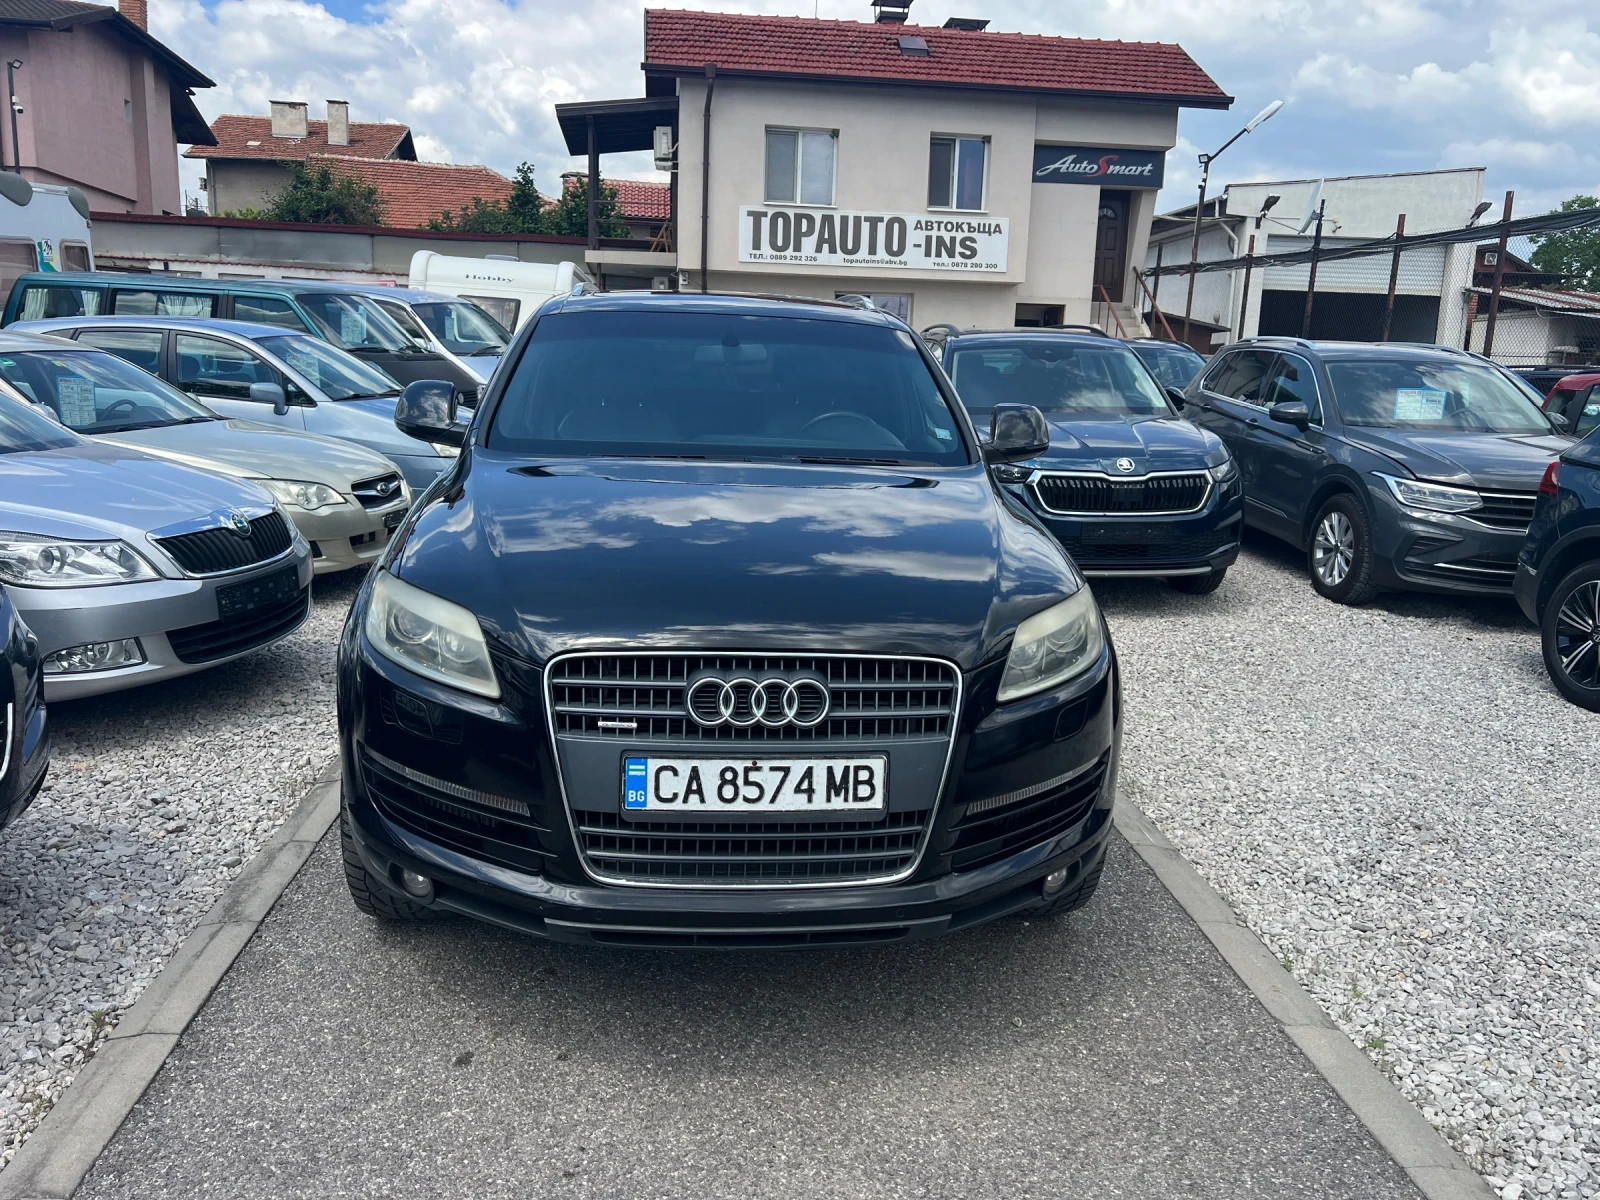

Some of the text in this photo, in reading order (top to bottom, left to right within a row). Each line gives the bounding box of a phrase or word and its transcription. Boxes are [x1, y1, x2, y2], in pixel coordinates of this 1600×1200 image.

[746, 210, 907, 257] TOPAUTO
[913, 219, 1003, 236] АВТОКЪЩА
[843, 257, 908, 267] topautoins@abv.bg
[465, 274, 515, 283] Hobby
[653, 765, 877, 804] CA 8574 MB
[627, 790, 645, 803] BG
